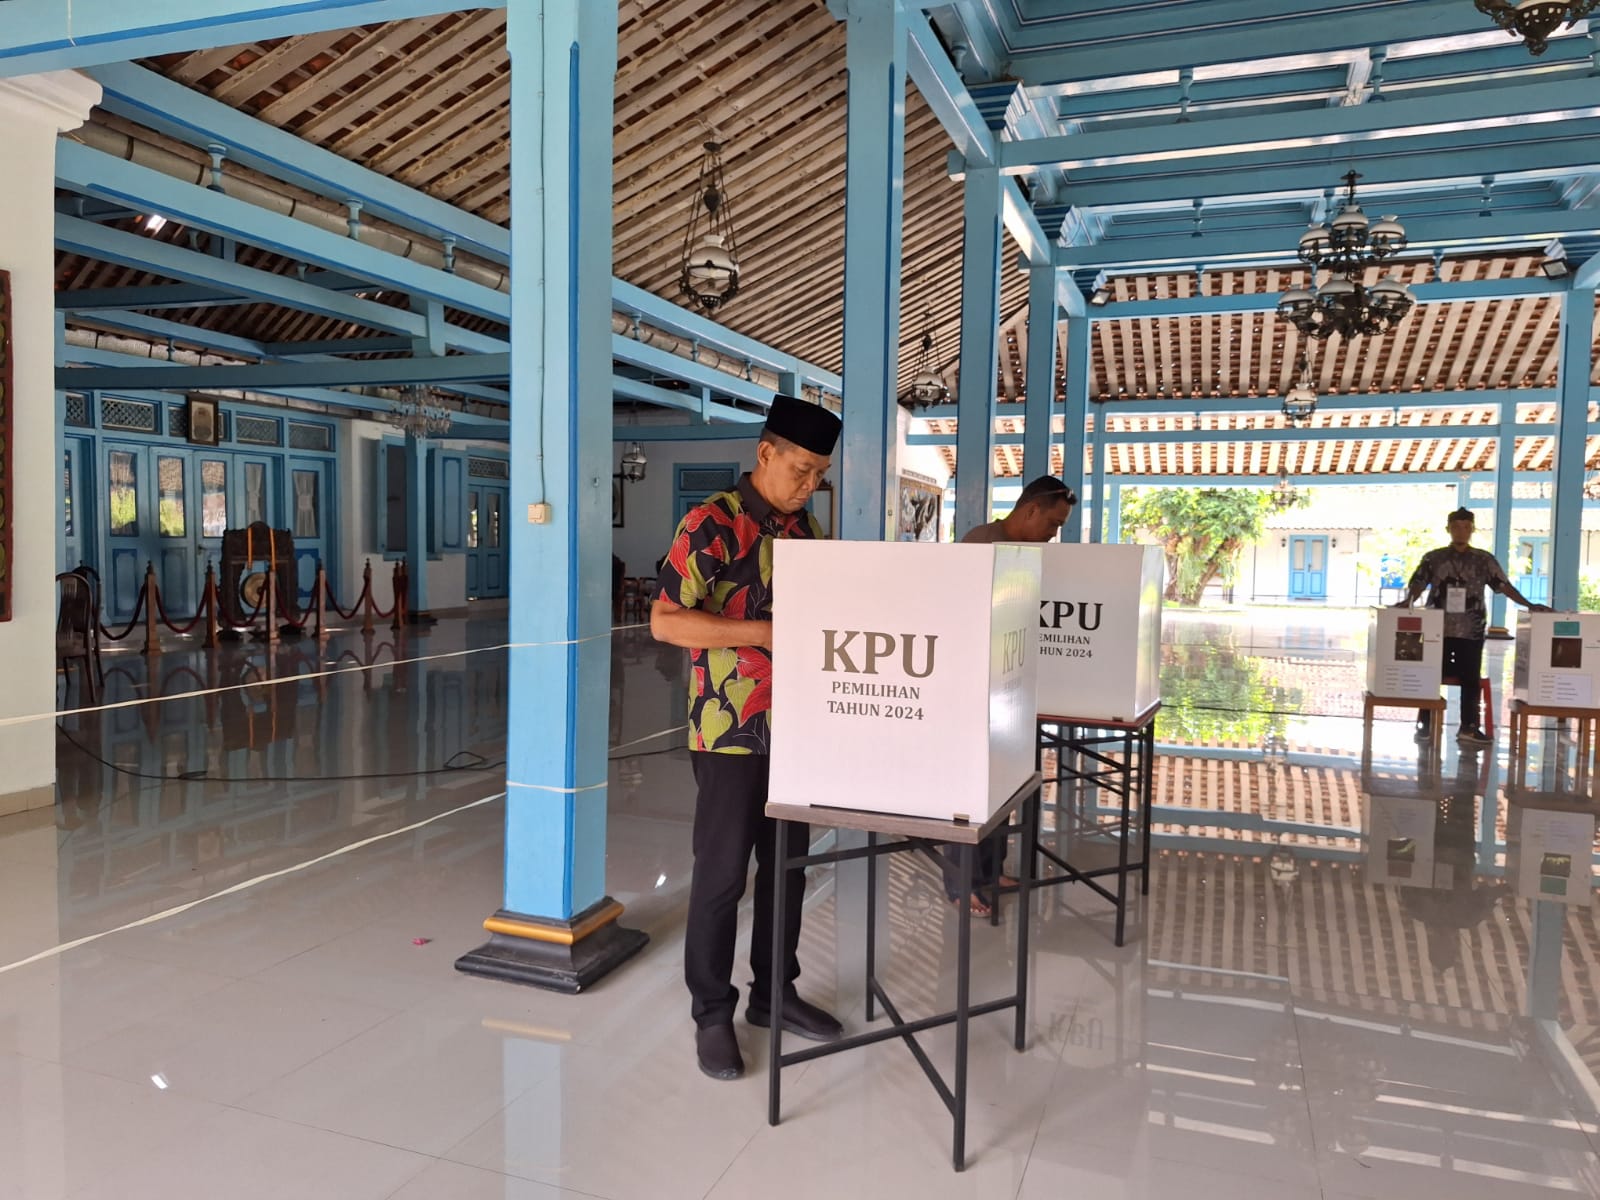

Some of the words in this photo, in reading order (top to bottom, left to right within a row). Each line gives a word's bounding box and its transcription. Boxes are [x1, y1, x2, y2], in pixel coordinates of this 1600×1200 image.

[821, 629, 939, 678] KPU
[1002, 627, 1027, 675] KPU
[1040, 646, 1063, 656] HUN
[1065, 648, 1093, 659] 2024
[832, 681, 920, 700] PEMILIHAN
[827, 700, 880, 717] TAHUN
[884, 704, 924, 721] 2024
